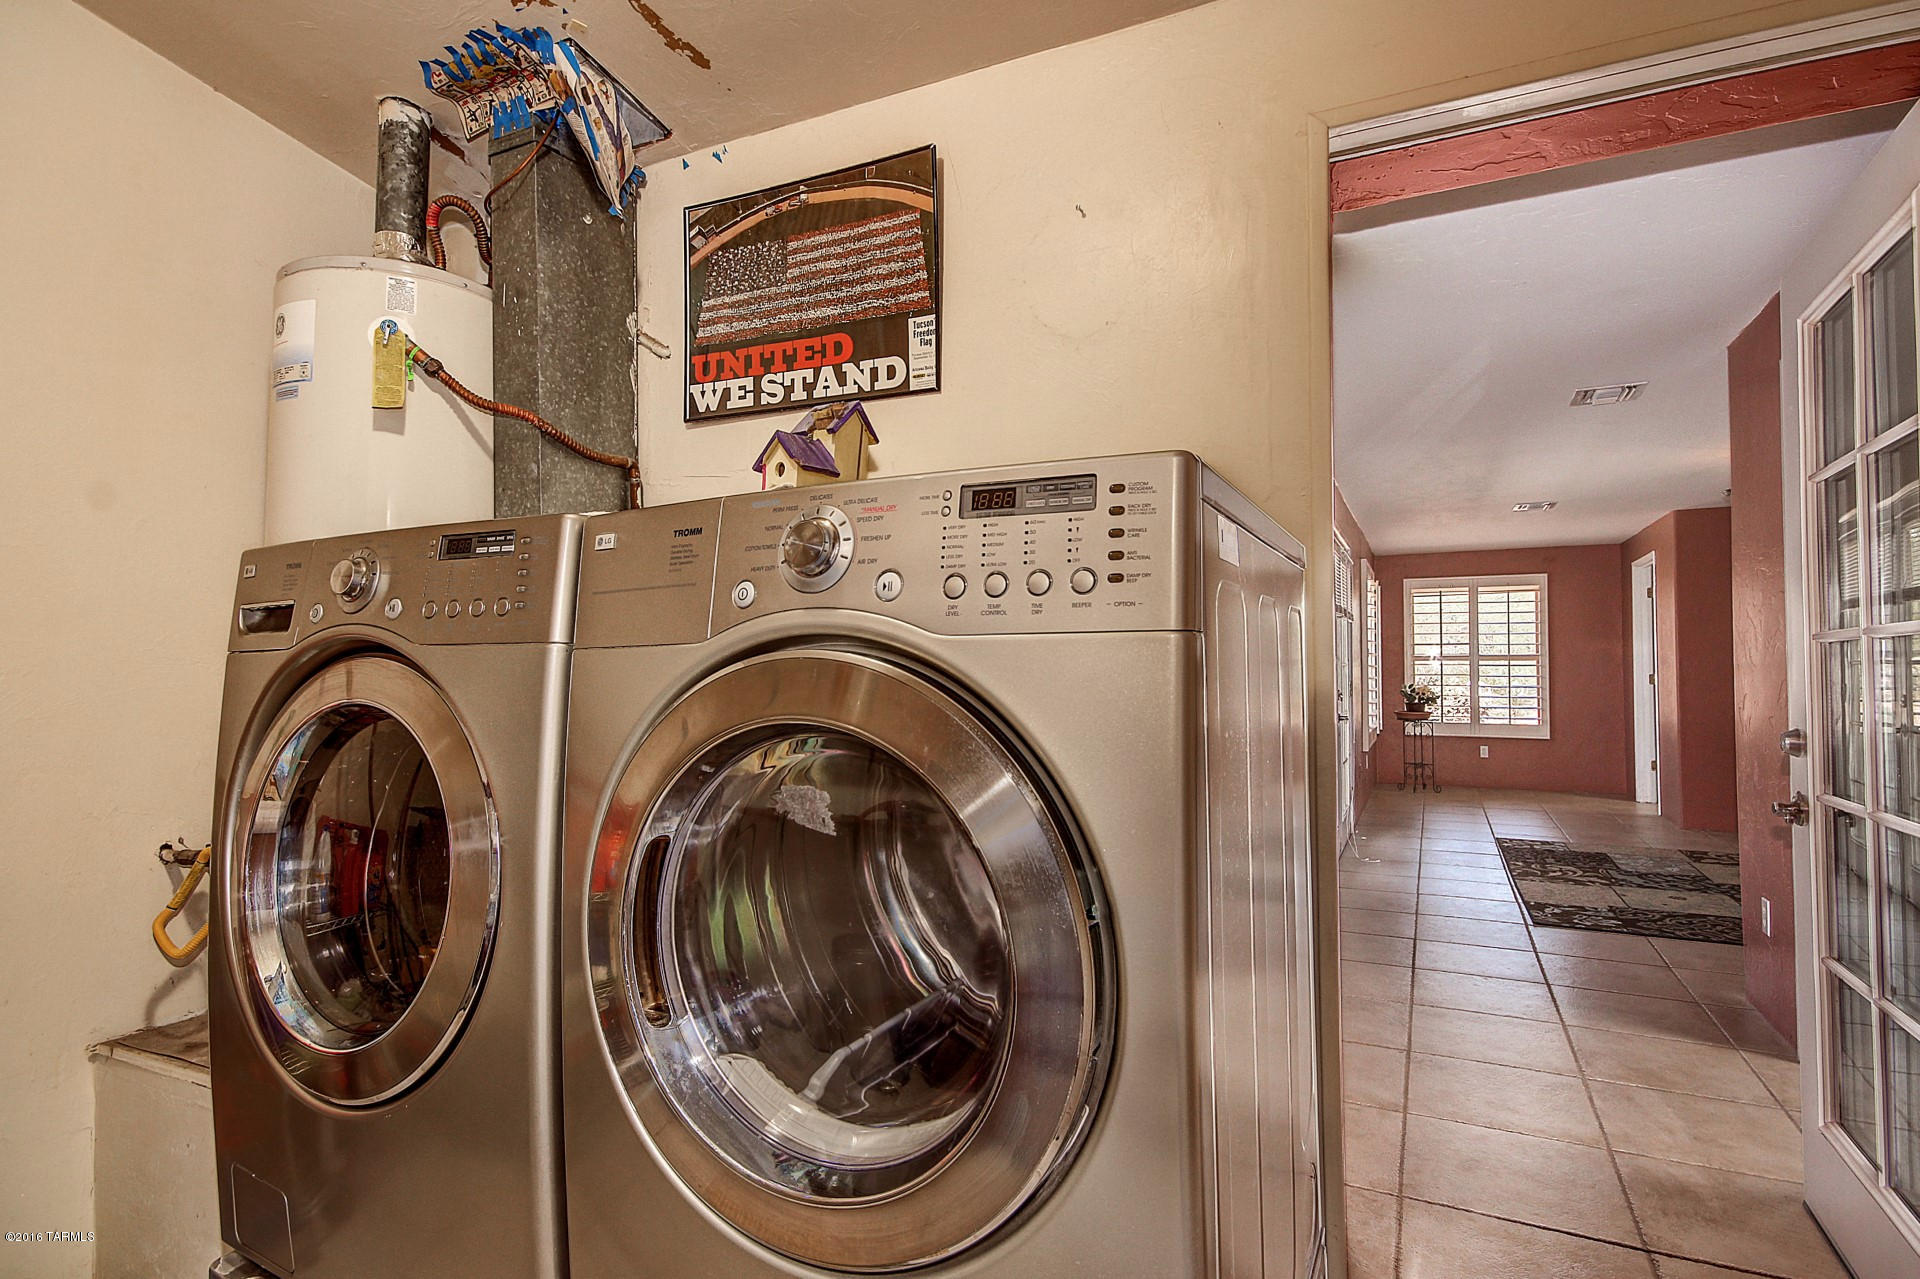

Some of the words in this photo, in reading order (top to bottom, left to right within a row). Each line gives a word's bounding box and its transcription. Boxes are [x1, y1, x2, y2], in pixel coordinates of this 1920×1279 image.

[913, 320, 934, 330] Tucson
[920, 338, 932, 348] Flag
[691, 332, 854, 383] UNITED
[689, 376, 754, 413] WE
[760, 355, 907, 405] STAND
[673, 527, 704, 538] TROMM
